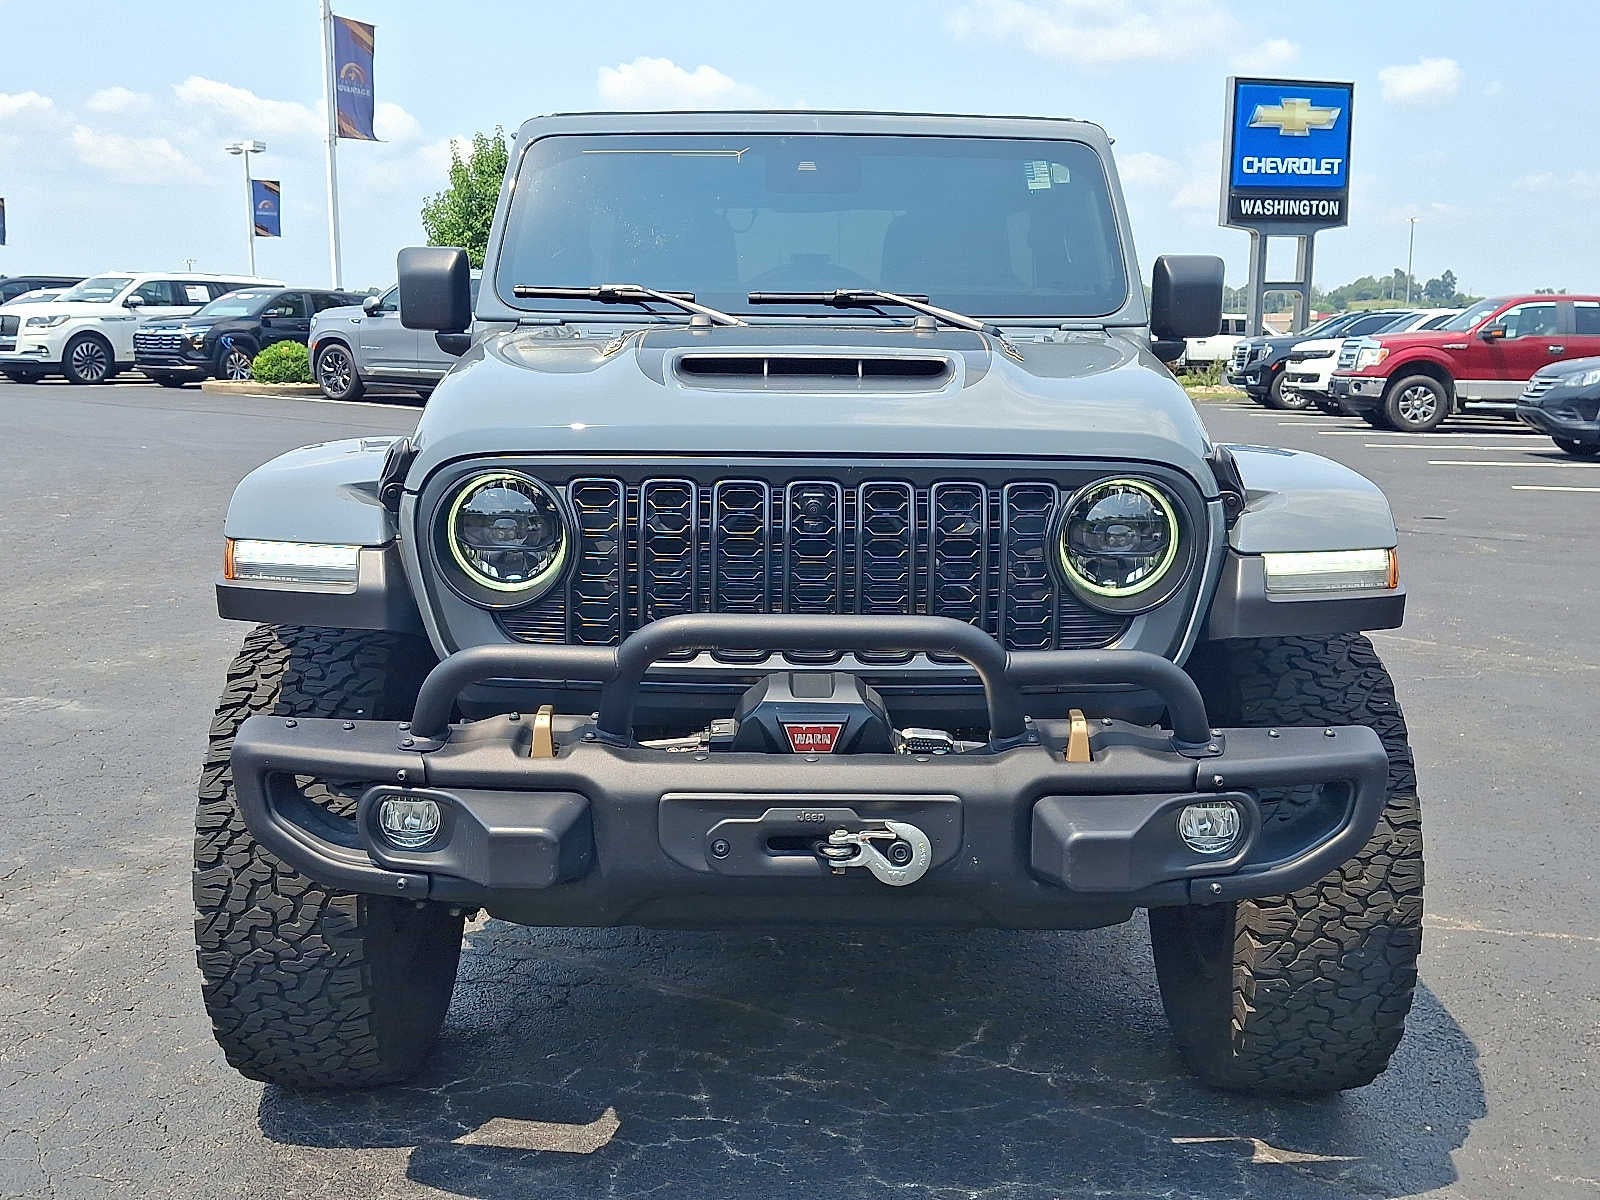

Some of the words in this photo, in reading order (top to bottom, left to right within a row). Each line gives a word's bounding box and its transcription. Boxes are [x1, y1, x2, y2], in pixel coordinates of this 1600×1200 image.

[1242, 156, 1342, 175] CHEVROLET
[1240, 199, 1340, 216] WASHINGTON
[793, 733, 831, 745] WARN
[796, 810, 825, 822] Jeep
